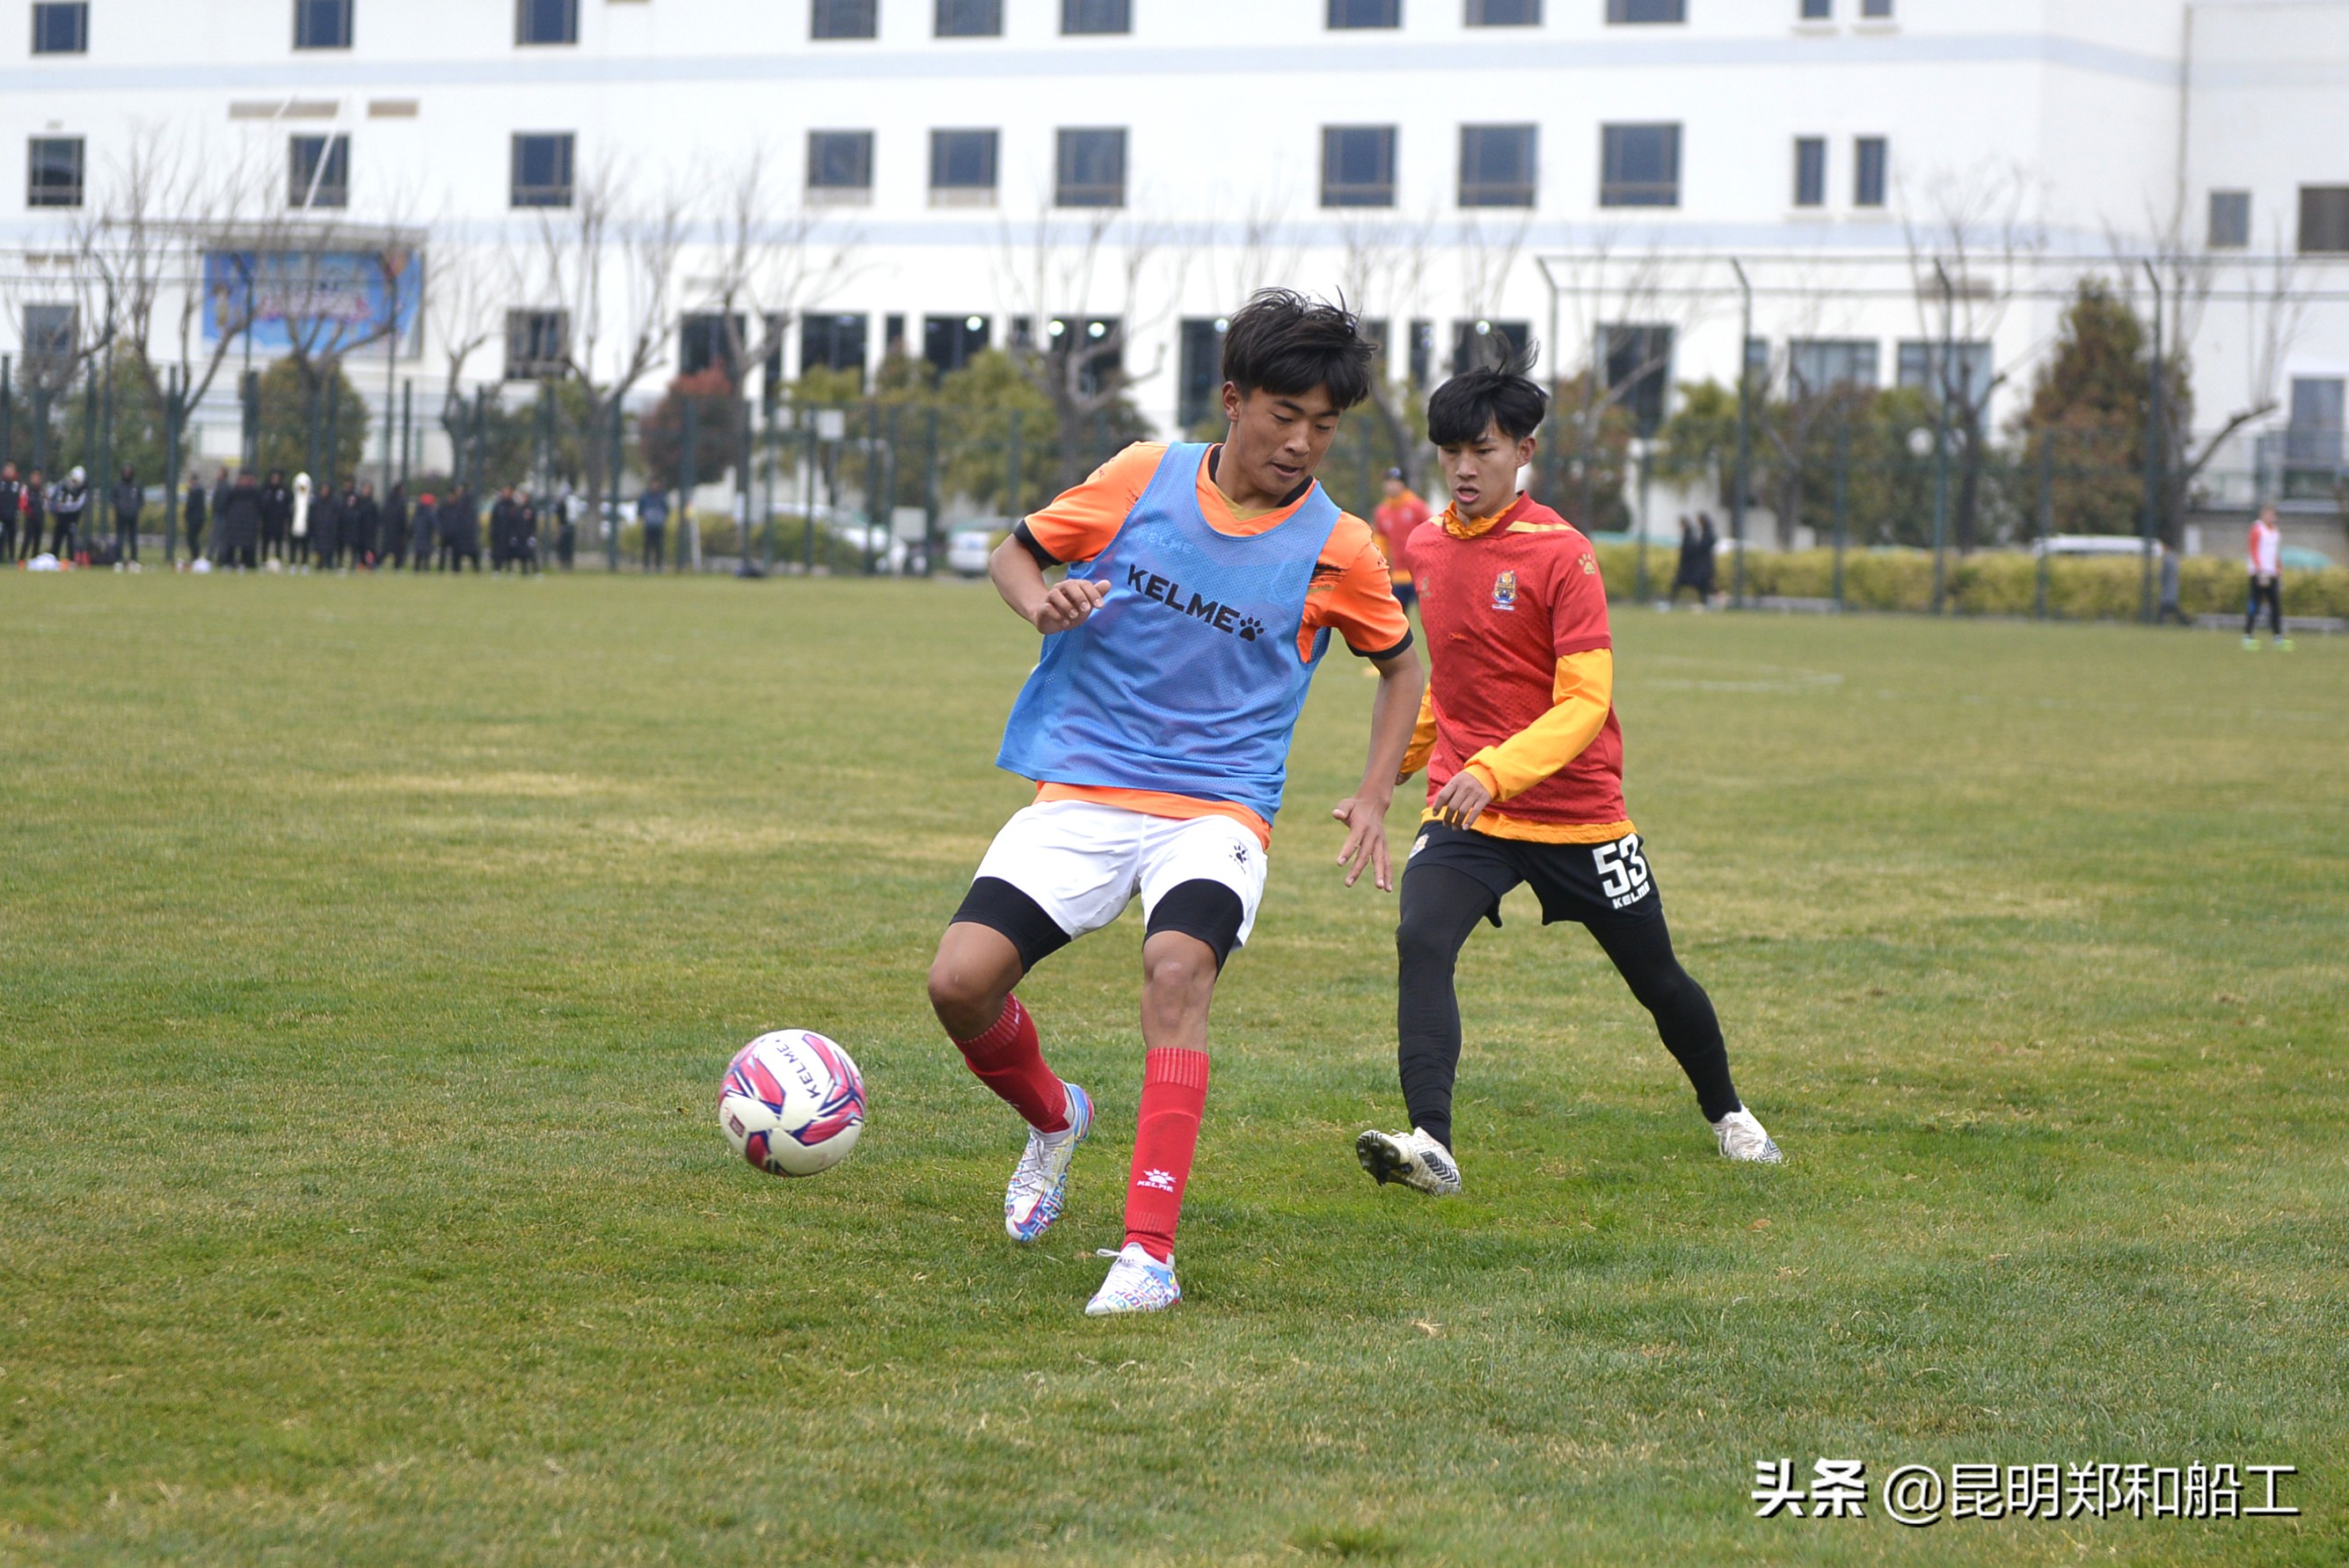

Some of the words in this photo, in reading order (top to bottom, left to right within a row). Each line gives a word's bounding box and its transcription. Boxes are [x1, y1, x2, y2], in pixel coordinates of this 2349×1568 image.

[1127, 564, 1241, 634] KELME
[1592, 833, 1647, 898] 53
[777, 1044, 821, 1099] KELME
[1136, 1180, 1174, 1192] KELME
